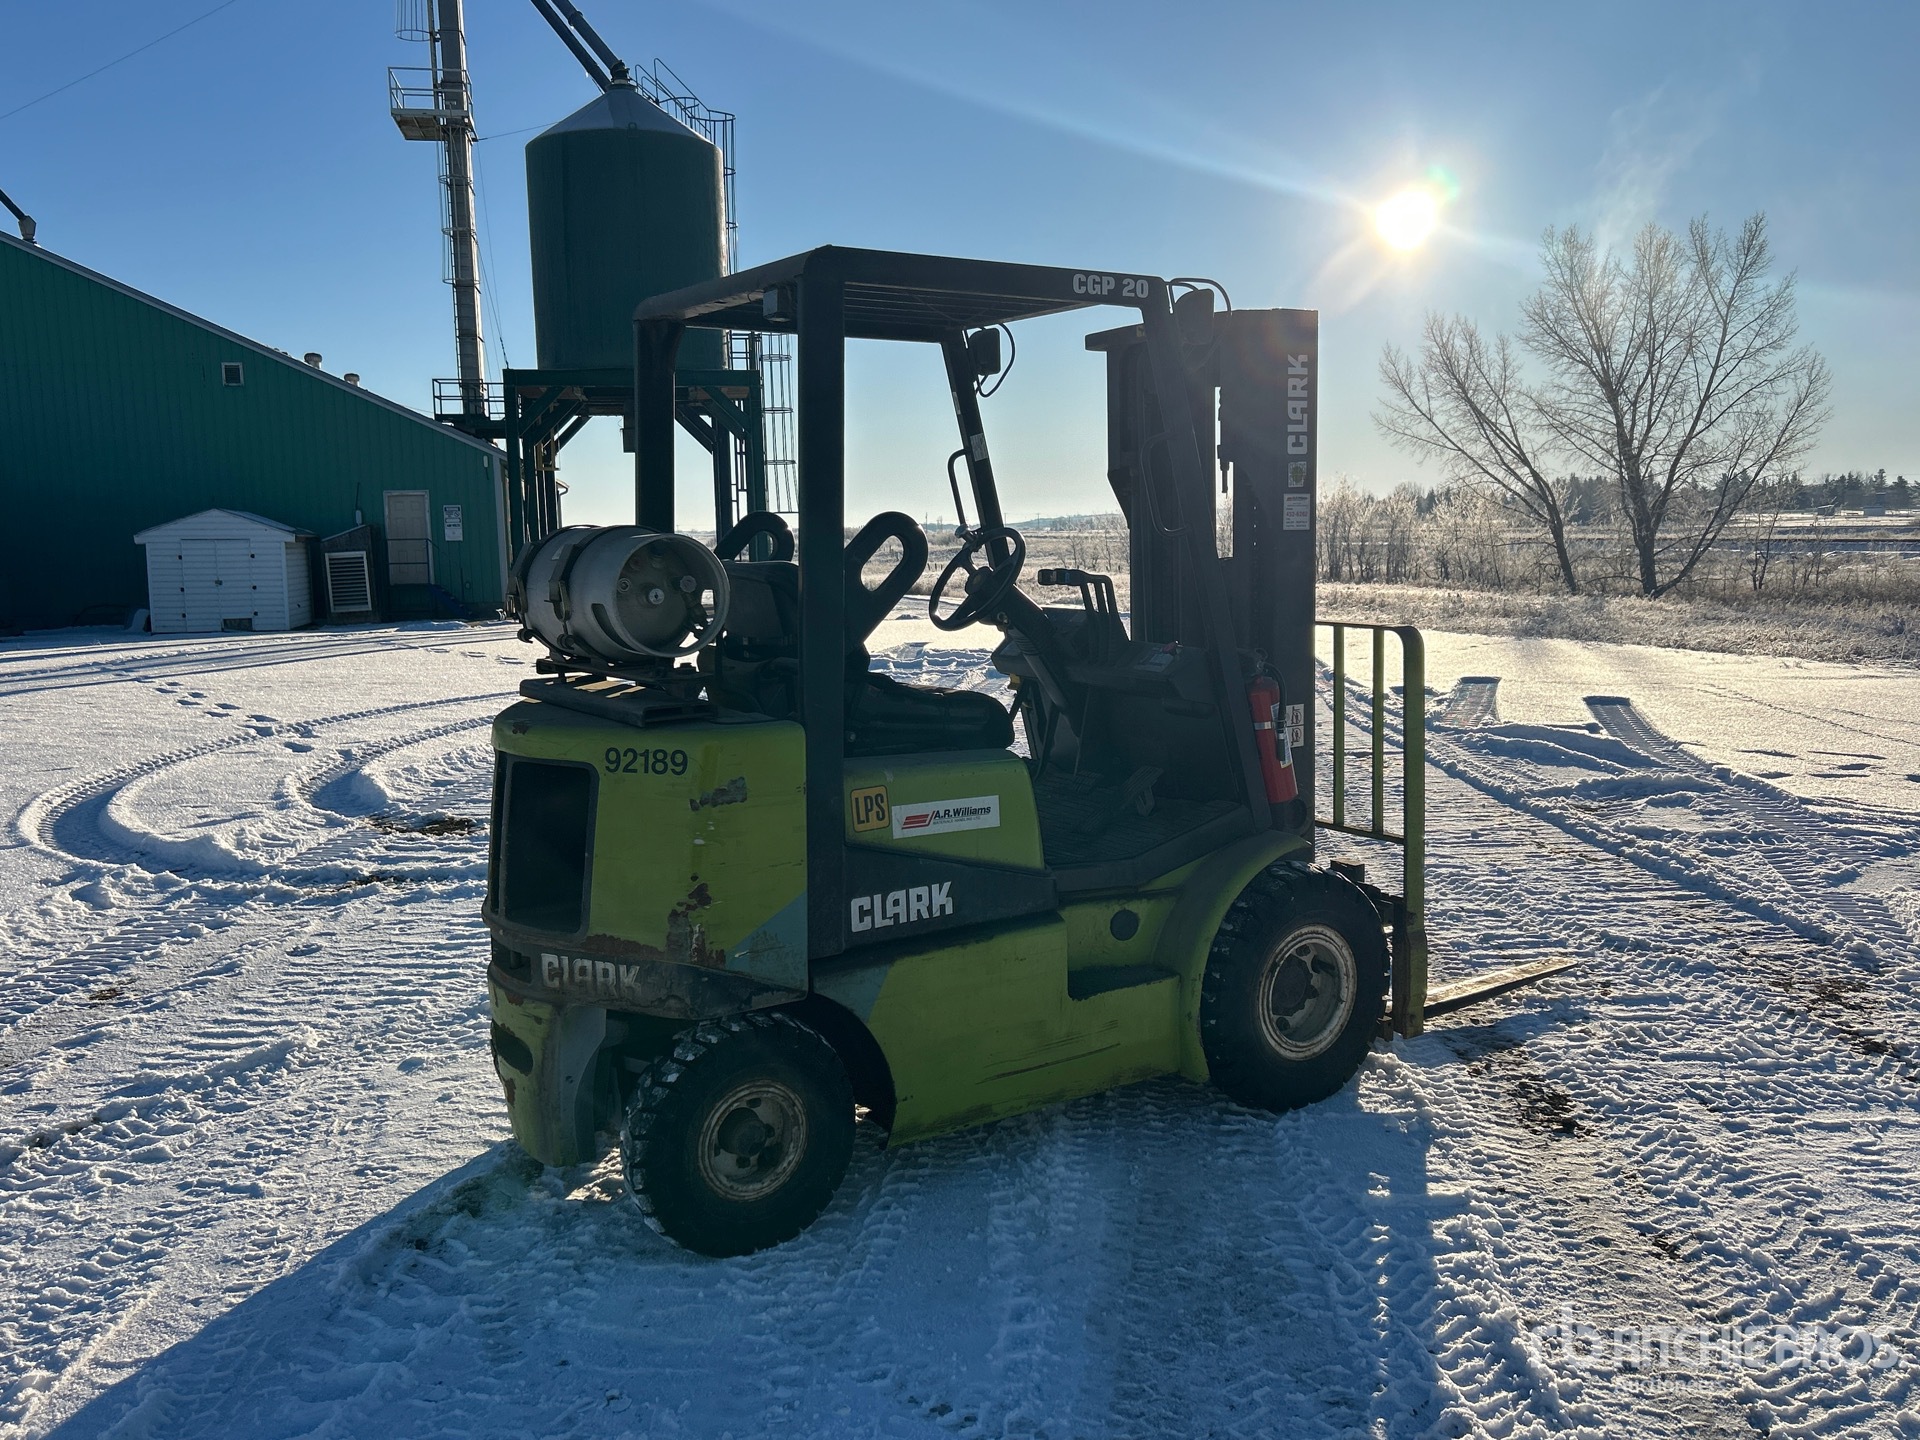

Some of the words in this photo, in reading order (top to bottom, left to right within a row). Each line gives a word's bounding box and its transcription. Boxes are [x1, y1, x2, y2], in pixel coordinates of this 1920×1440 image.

[1073, 274, 1115, 295] CGP
[1122, 278, 1149, 298] 20
[1287, 354, 1308, 455] CLARK
[605, 747, 688, 775] 92189
[855, 793, 886, 824] LPS
[851, 882, 953, 932] CLARK
[541, 953, 641, 999] CLARK
